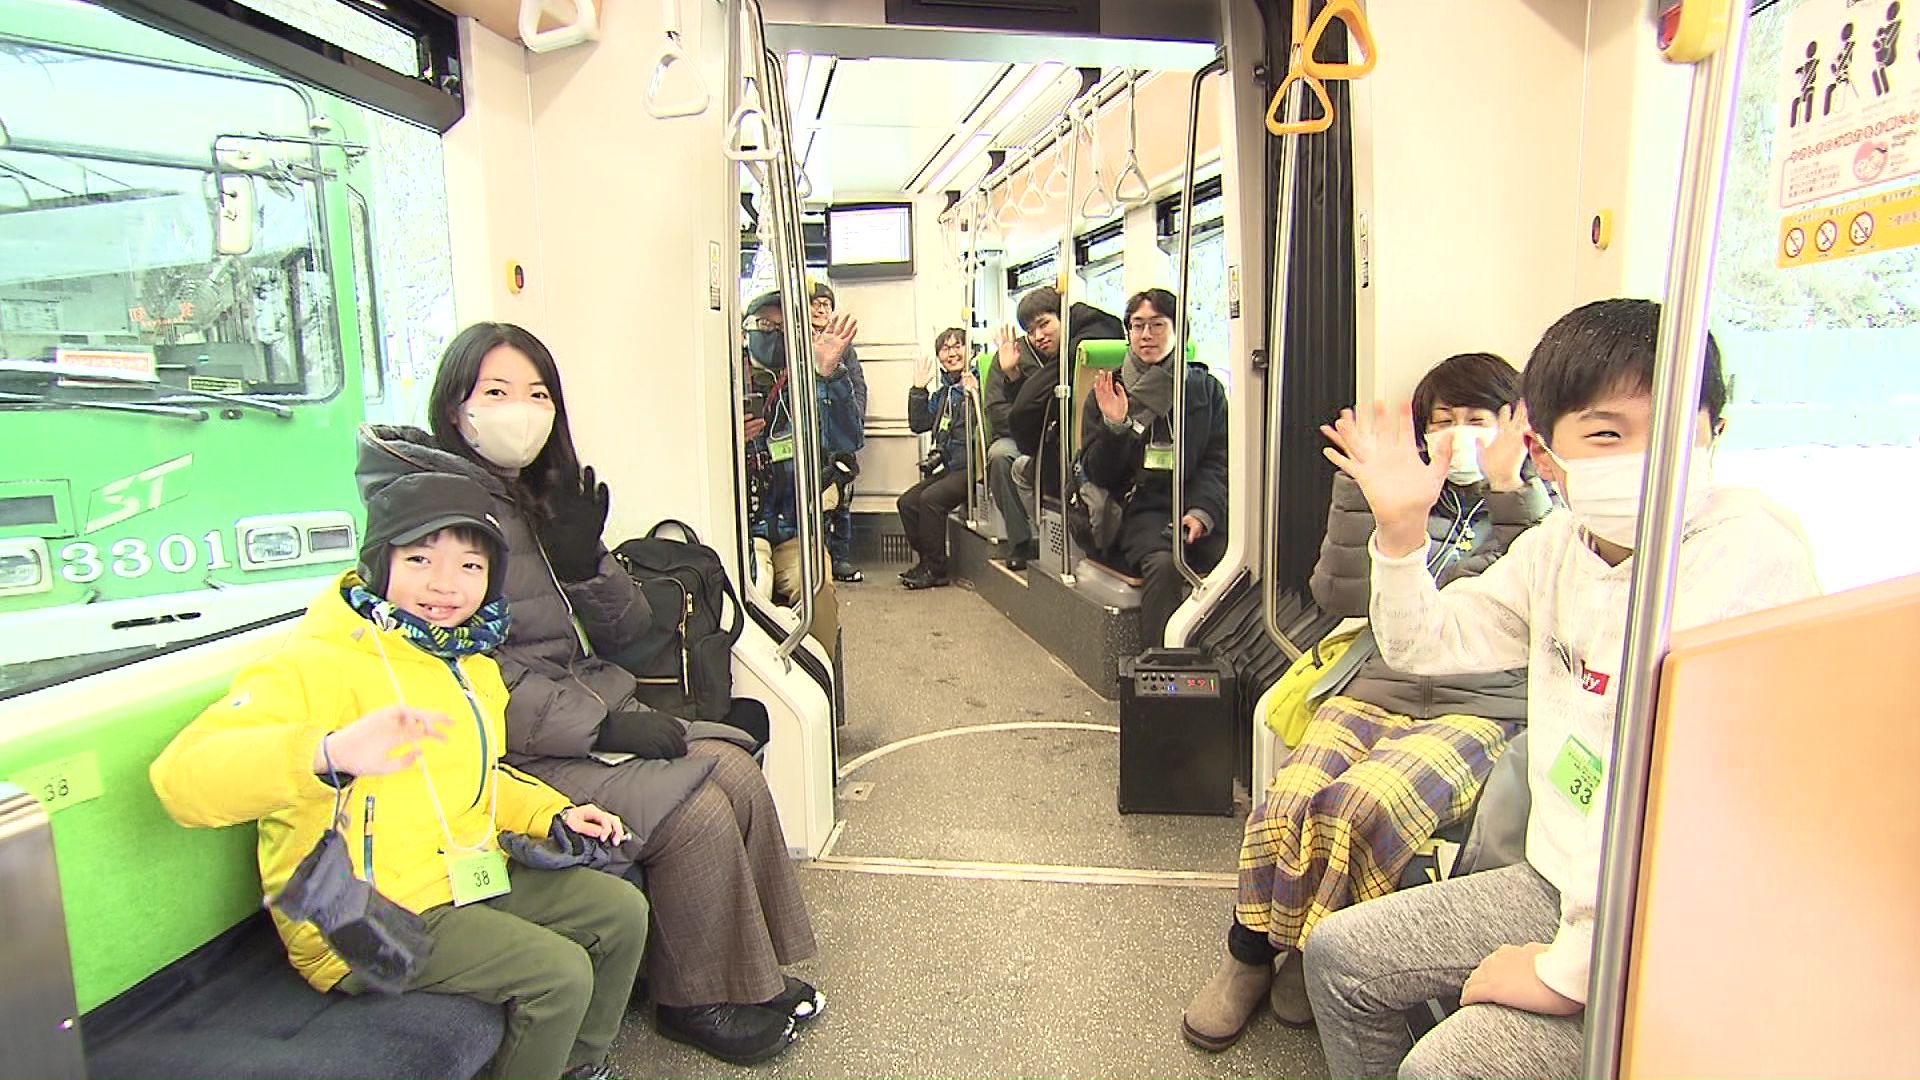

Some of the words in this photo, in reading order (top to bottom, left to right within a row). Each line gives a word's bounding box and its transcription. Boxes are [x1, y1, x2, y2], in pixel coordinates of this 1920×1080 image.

[86, 453, 193, 534] ST
[60, 529, 233, 584] 3301
[43, 778, 70, 802] 38
[1570, 778, 1593, 805] 33
[472, 870, 491, 888] 38
